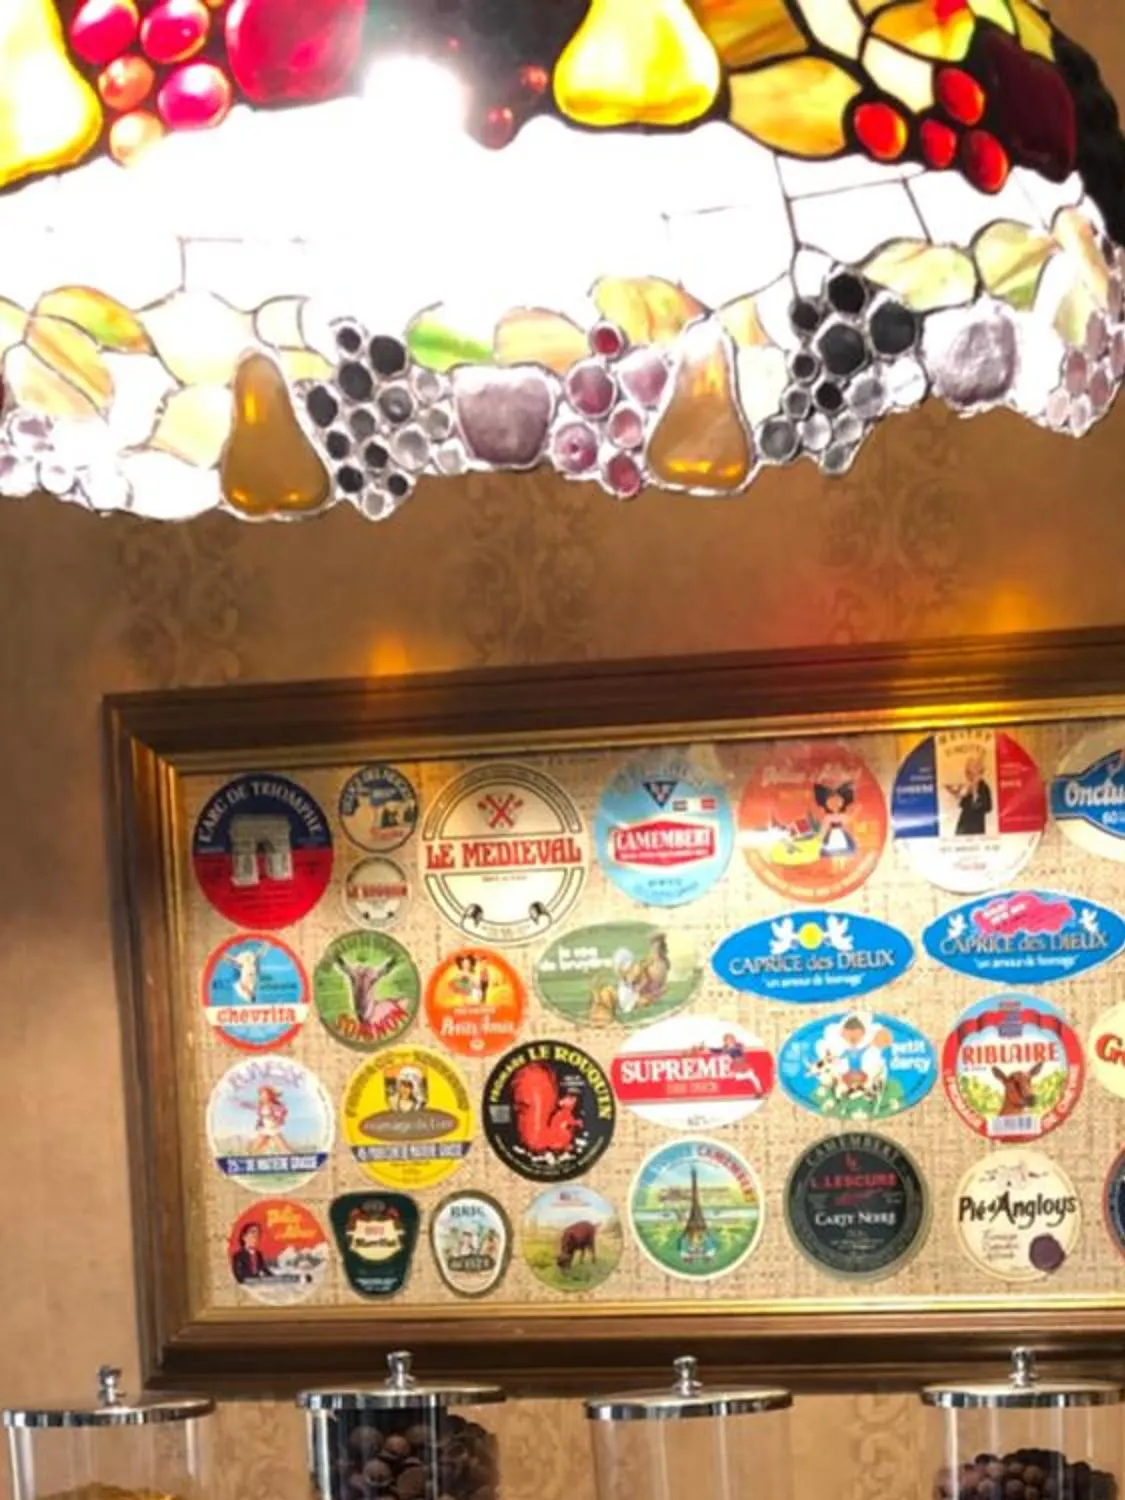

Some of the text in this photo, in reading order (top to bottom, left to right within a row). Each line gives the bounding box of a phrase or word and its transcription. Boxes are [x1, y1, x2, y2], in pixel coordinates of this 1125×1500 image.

[251, 781, 323, 833] TRIOMPHE
[616, 828, 711, 849] CAMEMBERT
[425, 837, 582, 870] LE MEDIEVAL
[939, 932, 1110, 955] CAPRICE des DIEUX
[728, 949, 896, 976] CAPRICE des DIEUX
[528, 1045, 551, 1061] LE
[961, 1042, 1059, 1065] RIBLAIRE
